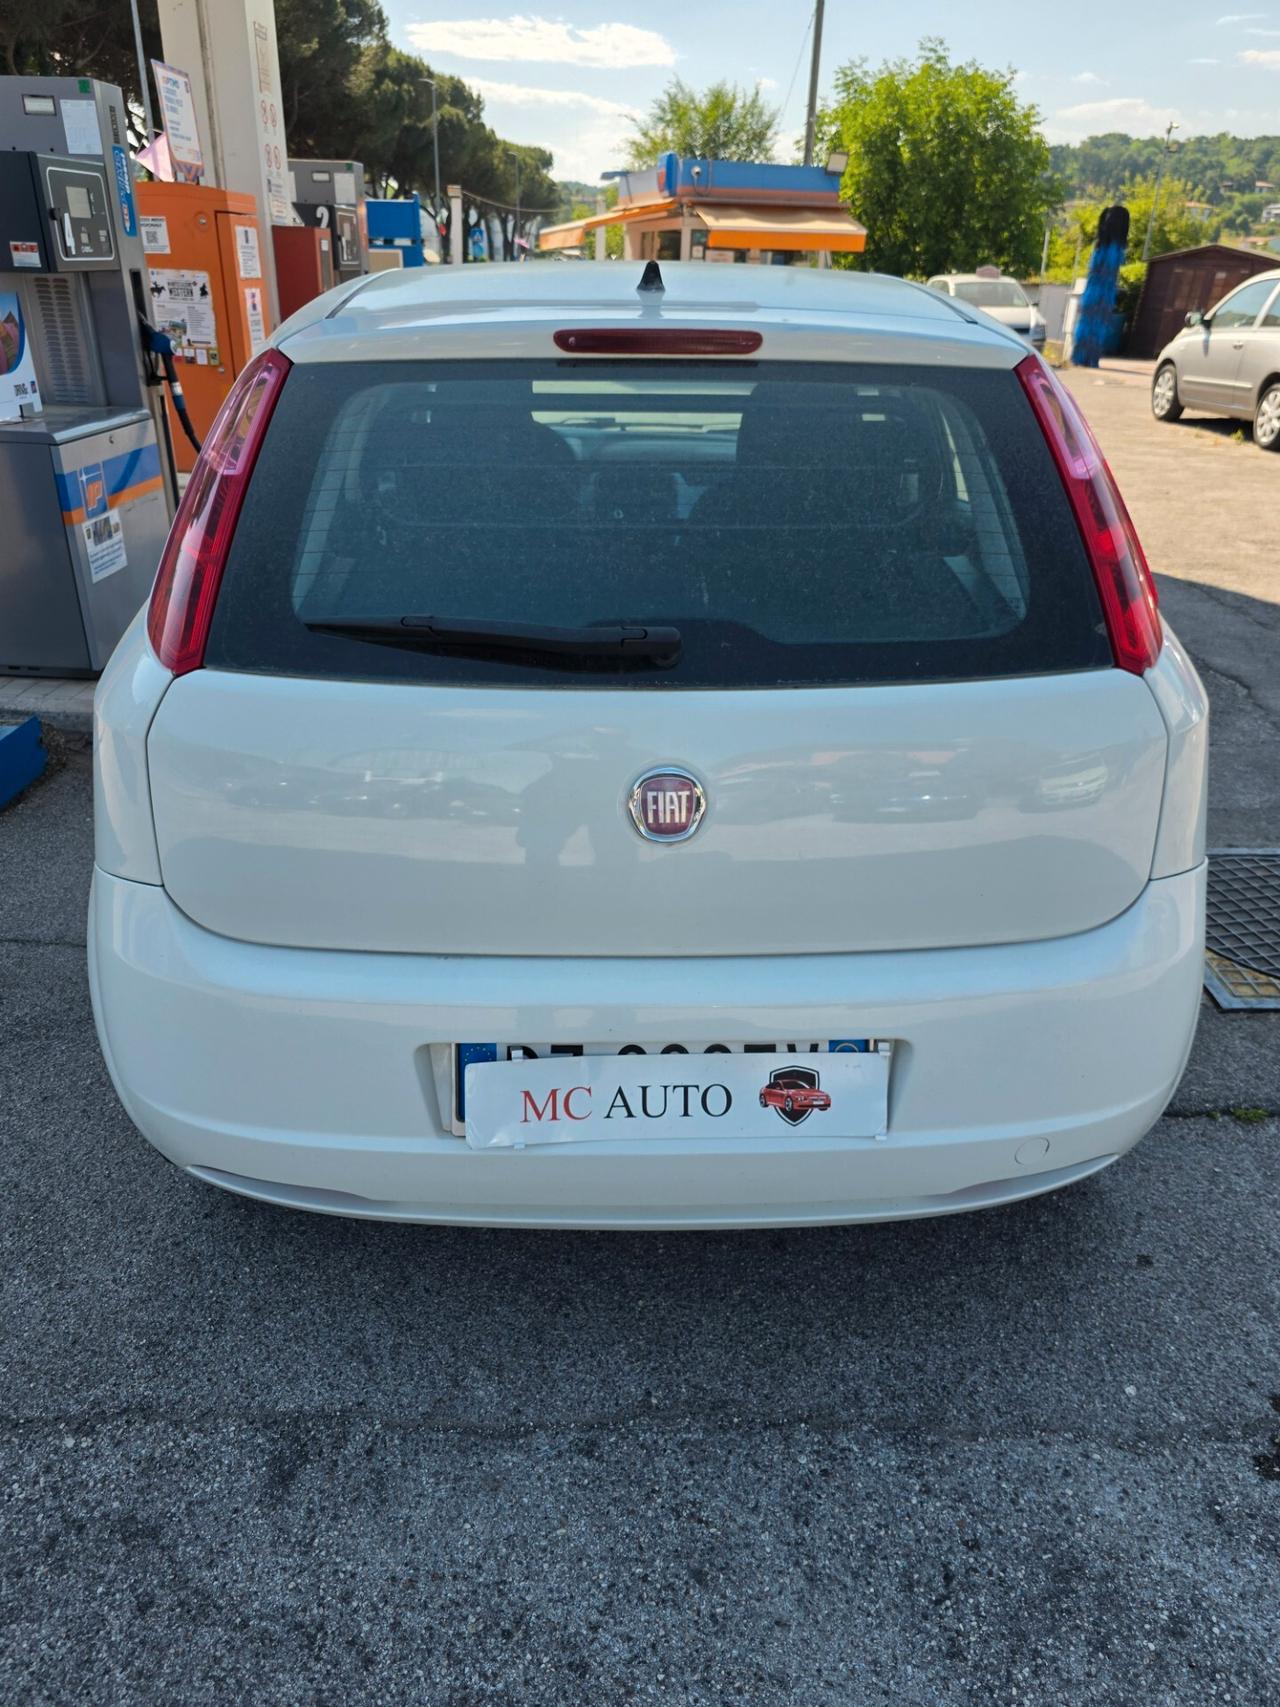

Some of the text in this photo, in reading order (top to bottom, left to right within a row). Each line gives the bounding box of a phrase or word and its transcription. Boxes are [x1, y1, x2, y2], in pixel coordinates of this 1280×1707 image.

[647, 791, 690, 823] FIAT
[520, 1083, 732, 1123] MC AUTO
